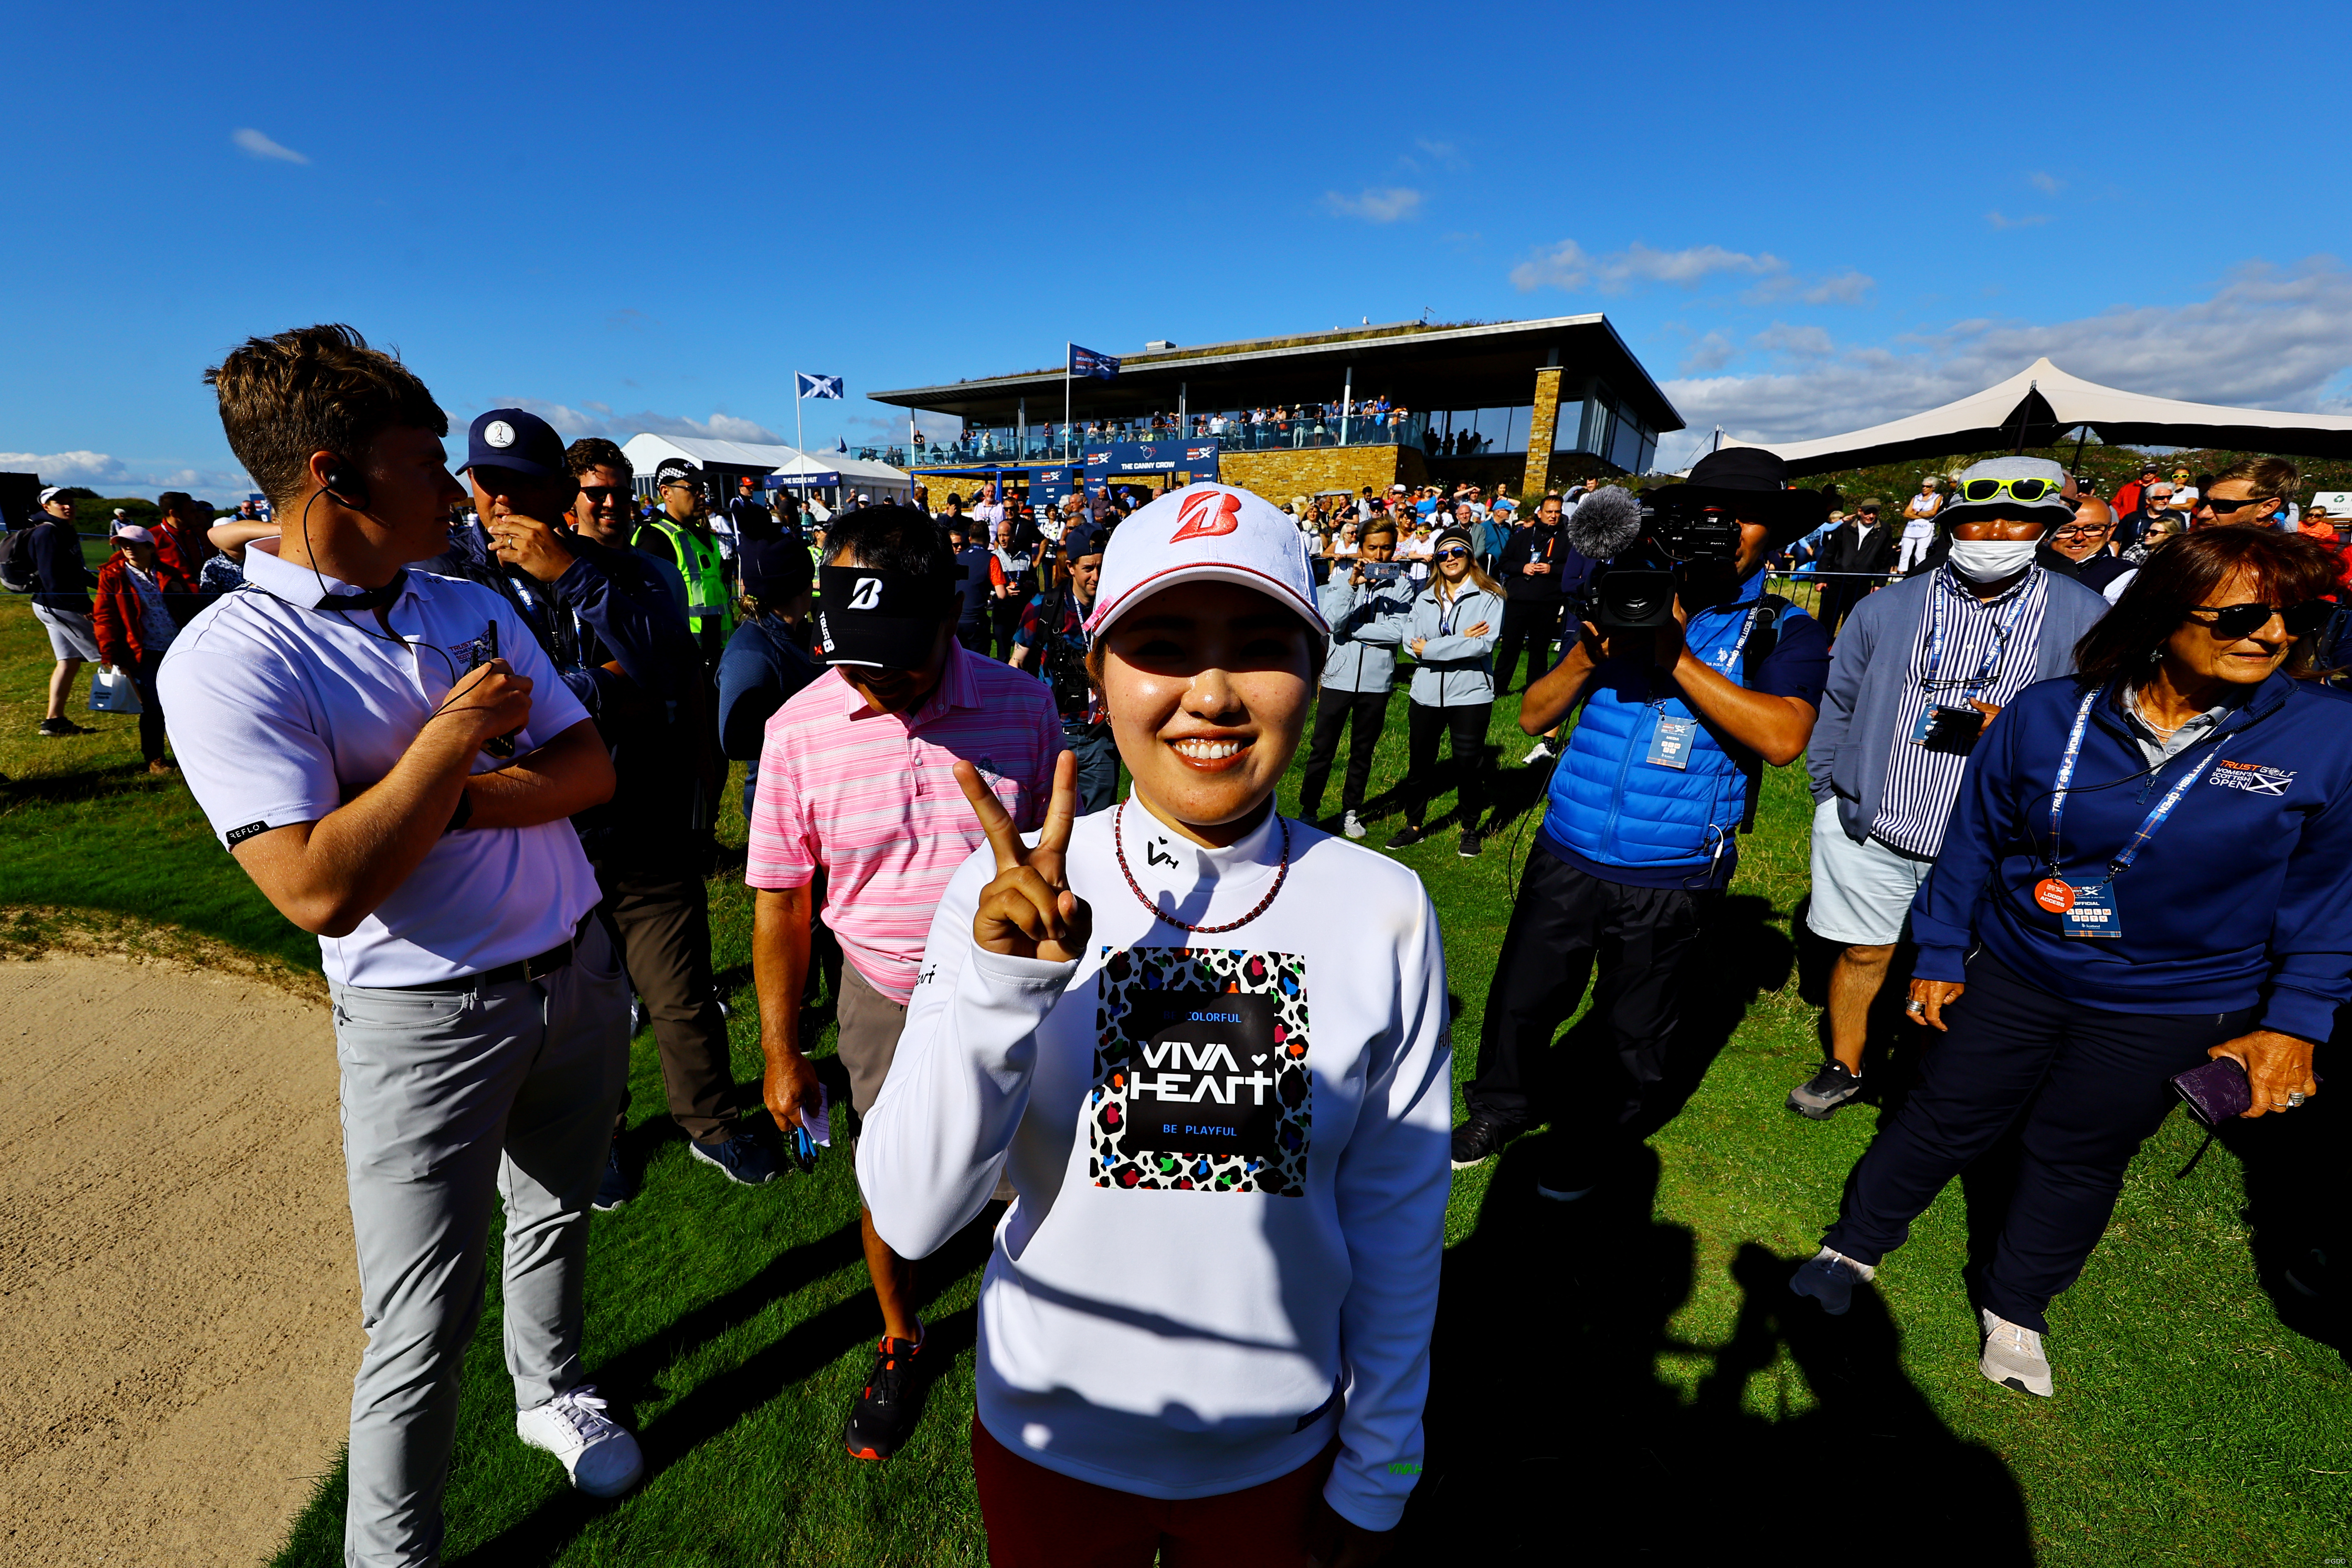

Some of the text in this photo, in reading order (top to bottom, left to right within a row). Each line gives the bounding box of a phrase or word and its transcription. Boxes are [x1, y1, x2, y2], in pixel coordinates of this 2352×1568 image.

[519, 590, 533, 606] OPEN
[1983, 572, 2038, 667] TRUST GLF WOMEN'S SCOTTISH
[819, 611, 835, 653] TOUR B
[1736, 621, 1753, 649] SCOTTISH
[448, 640, 472, 652] TRUST
[452, 646, 474, 656] WOMEN
[456, 652, 473, 660] SCOTT
[1726, 650, 1740, 667] OPEN
[2060, 758, 2073, 783] GOLF
[2067, 715, 2085, 754] WOMEN'S
[2216, 767, 2253, 776] WOMEN'S
[2220, 760, 2298, 778] TRUST GOLF
[2157, 753, 2215, 813] SCOTTISH OPEN
[2209, 777, 2248, 790] OPEN
[2212, 772, 2251, 782] SCOTTISH
[229, 824, 260, 838] REFLO
[2040, 896, 2065, 908] ACCESS
[2044, 891, 2065, 901] LODGE
[1185, 1012, 1241, 1023] COLORFUL
[1137, 1041, 1240, 1072] VIVA
[1163, 1124, 1237, 1136] BE PLAYFUL
